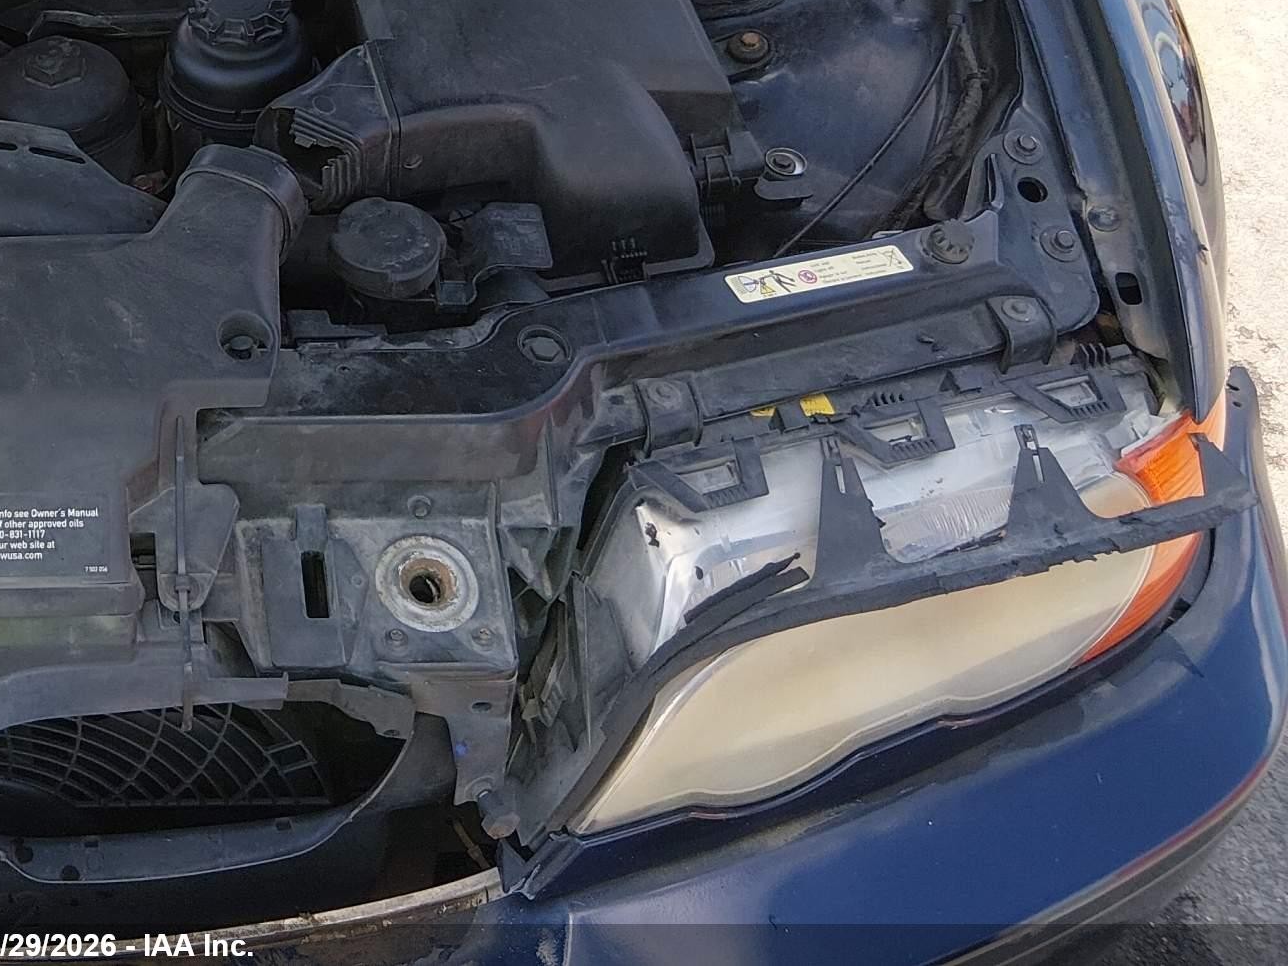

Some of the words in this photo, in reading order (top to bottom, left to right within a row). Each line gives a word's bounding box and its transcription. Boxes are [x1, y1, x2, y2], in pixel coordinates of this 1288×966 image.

[67, 507, 98, 518] Manual
[4, 520, 26, 529] other
[28, 519, 67, 530] approved
[69, 519, 84, 528] oils
[9, 540, 27, 549] web
[29, 540, 45, 549] site
[47, 540, 55, 549] at
